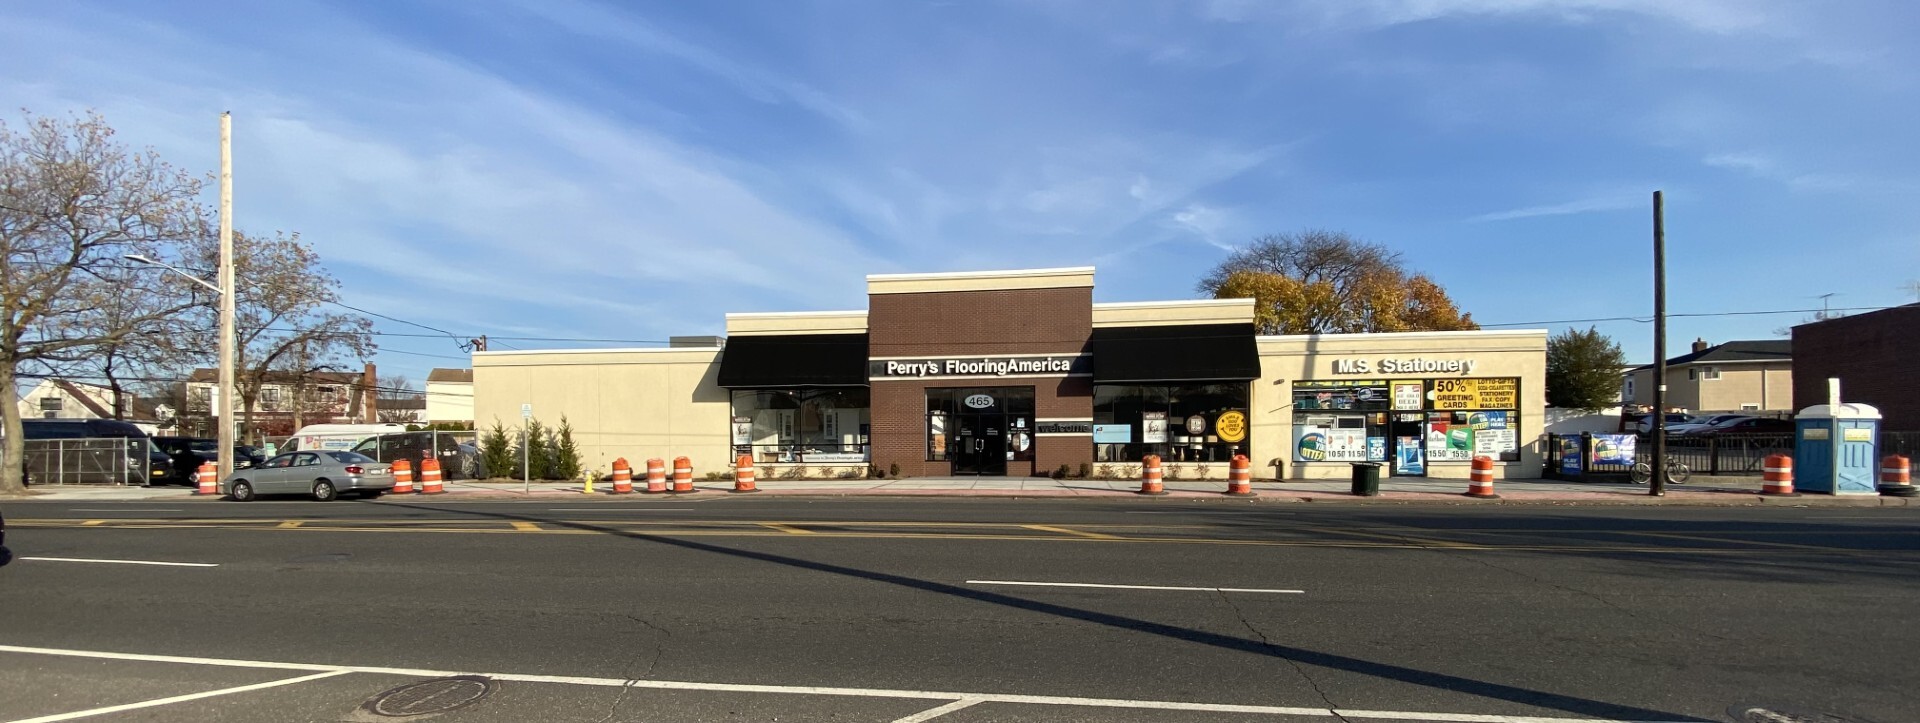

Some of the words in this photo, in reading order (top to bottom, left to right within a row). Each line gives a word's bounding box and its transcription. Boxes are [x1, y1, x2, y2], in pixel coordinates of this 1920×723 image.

[887, 360, 939, 377] Perry's
[945, 357, 1070, 375] FlooringAmerica
[1383, 357, 1478, 374] Stationery
[1437, 379, 1466, 392] 50%
[969, 397, 990, 405] 465
[1038, 423, 1089, 433] welcome
